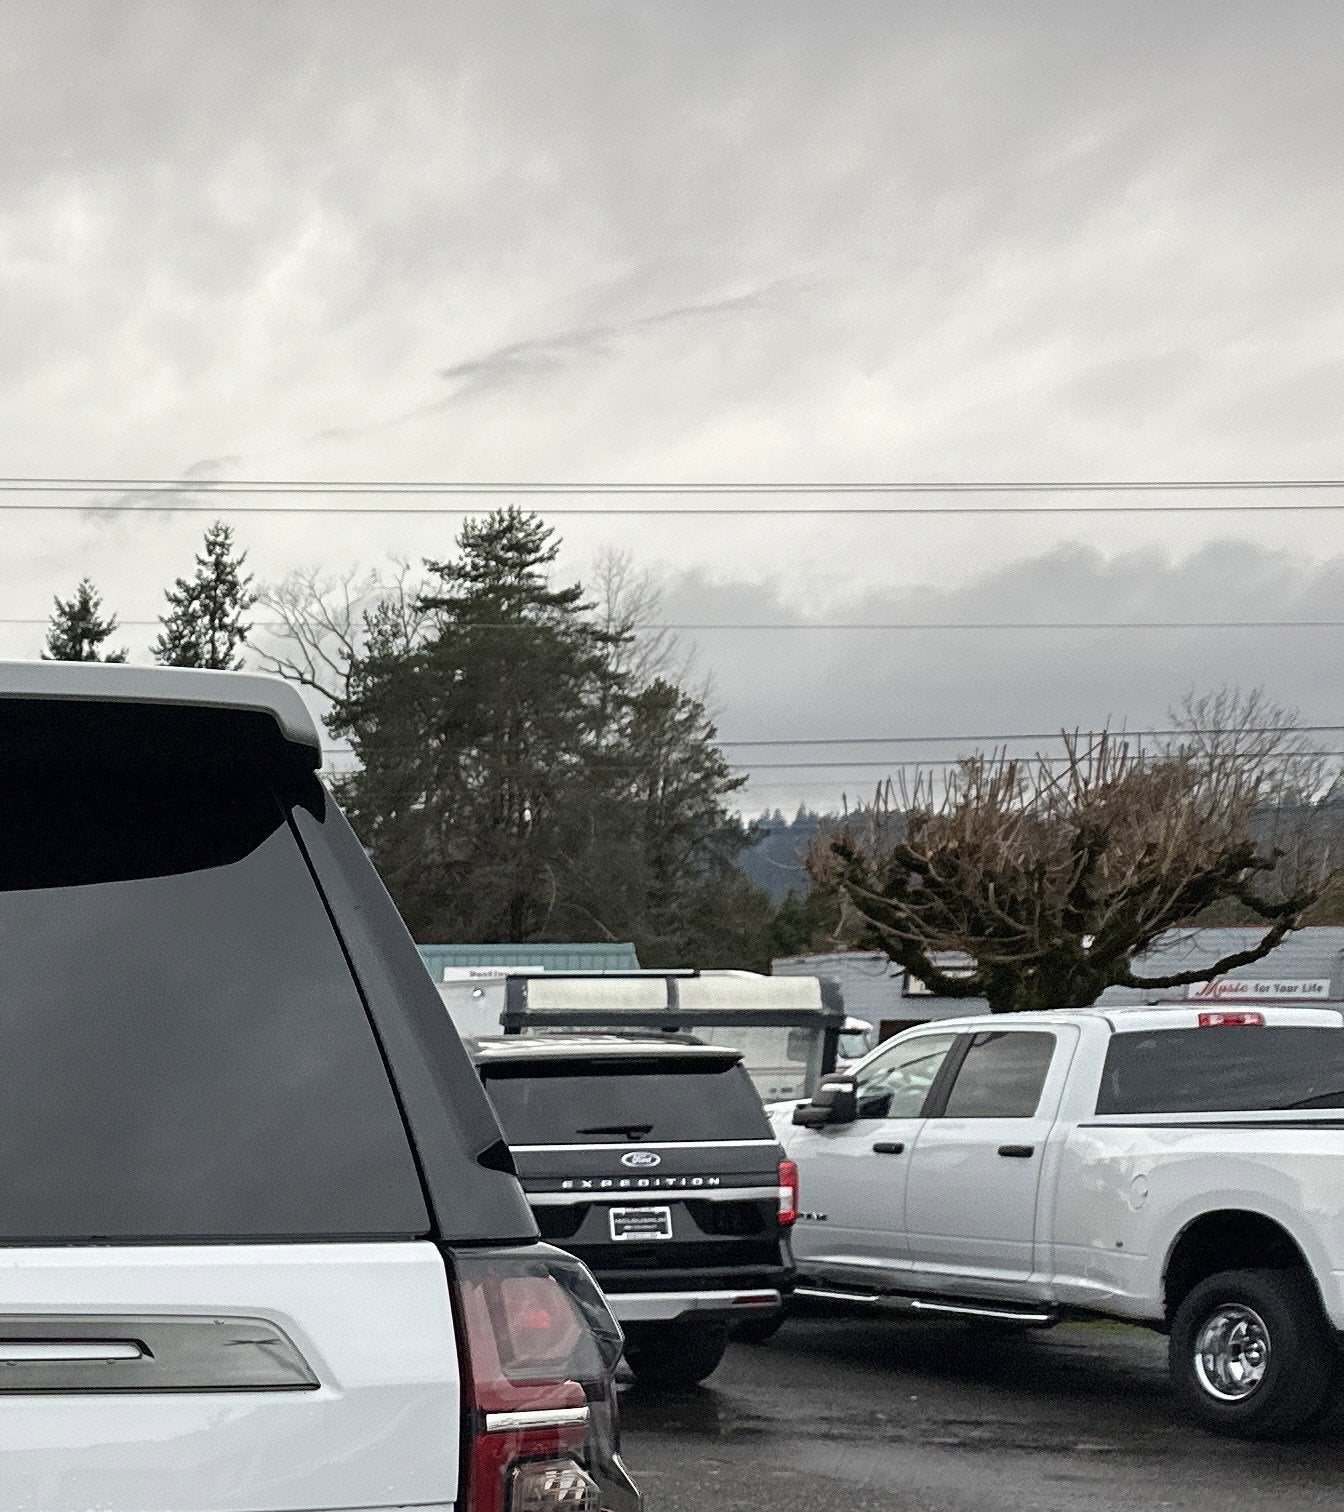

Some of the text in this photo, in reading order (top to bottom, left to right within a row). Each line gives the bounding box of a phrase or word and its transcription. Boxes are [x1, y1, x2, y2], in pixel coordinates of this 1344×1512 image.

[1196, 977, 1323, 997] Music for Your Life
[562, 1177, 720, 1189] EXPEDITION
